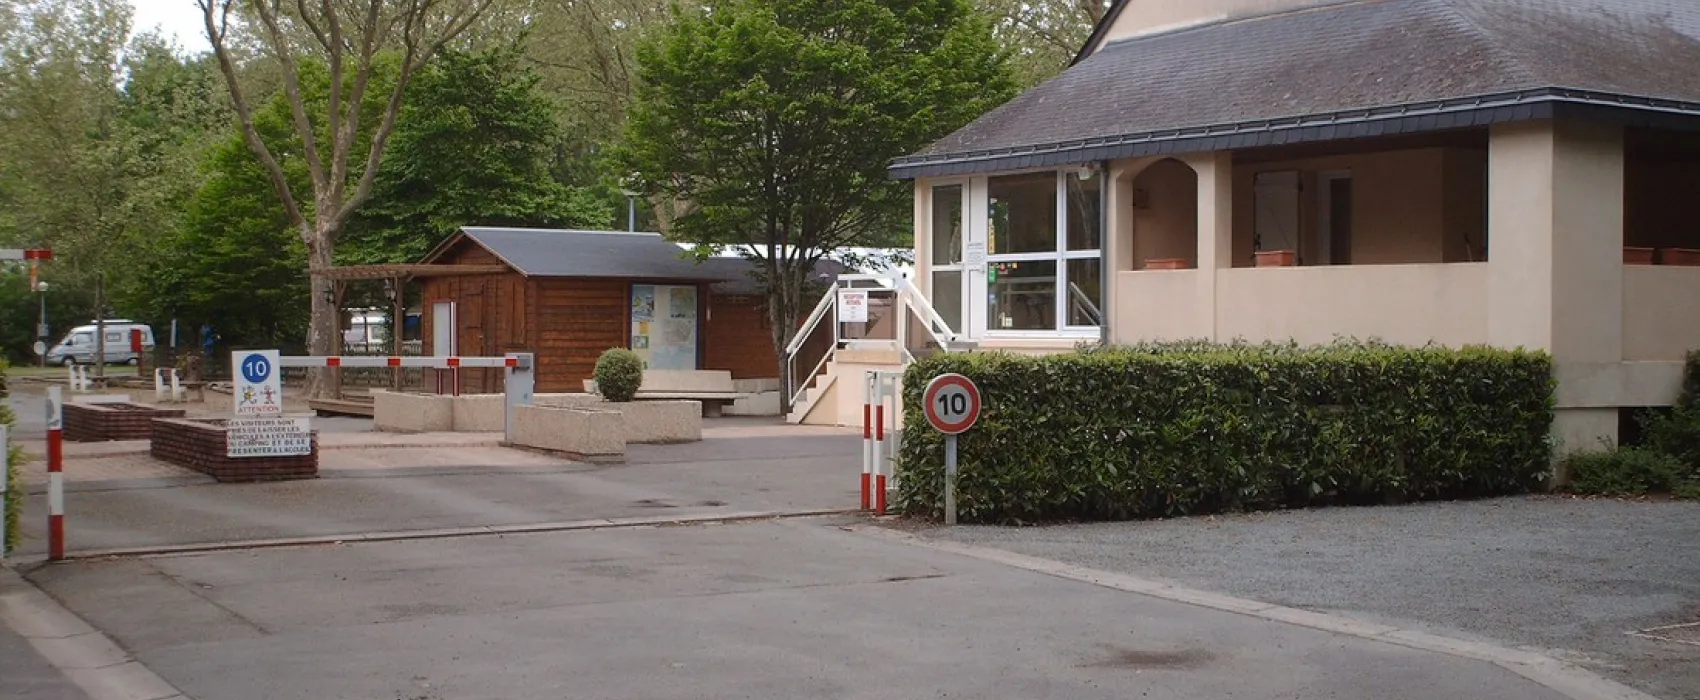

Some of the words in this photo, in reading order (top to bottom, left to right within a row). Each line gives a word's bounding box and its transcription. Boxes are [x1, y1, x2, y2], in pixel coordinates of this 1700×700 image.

[246, 361, 267, 377] 10
[238, 405, 279, 413] ATTENTION
[938, 393, 966, 415] 10
